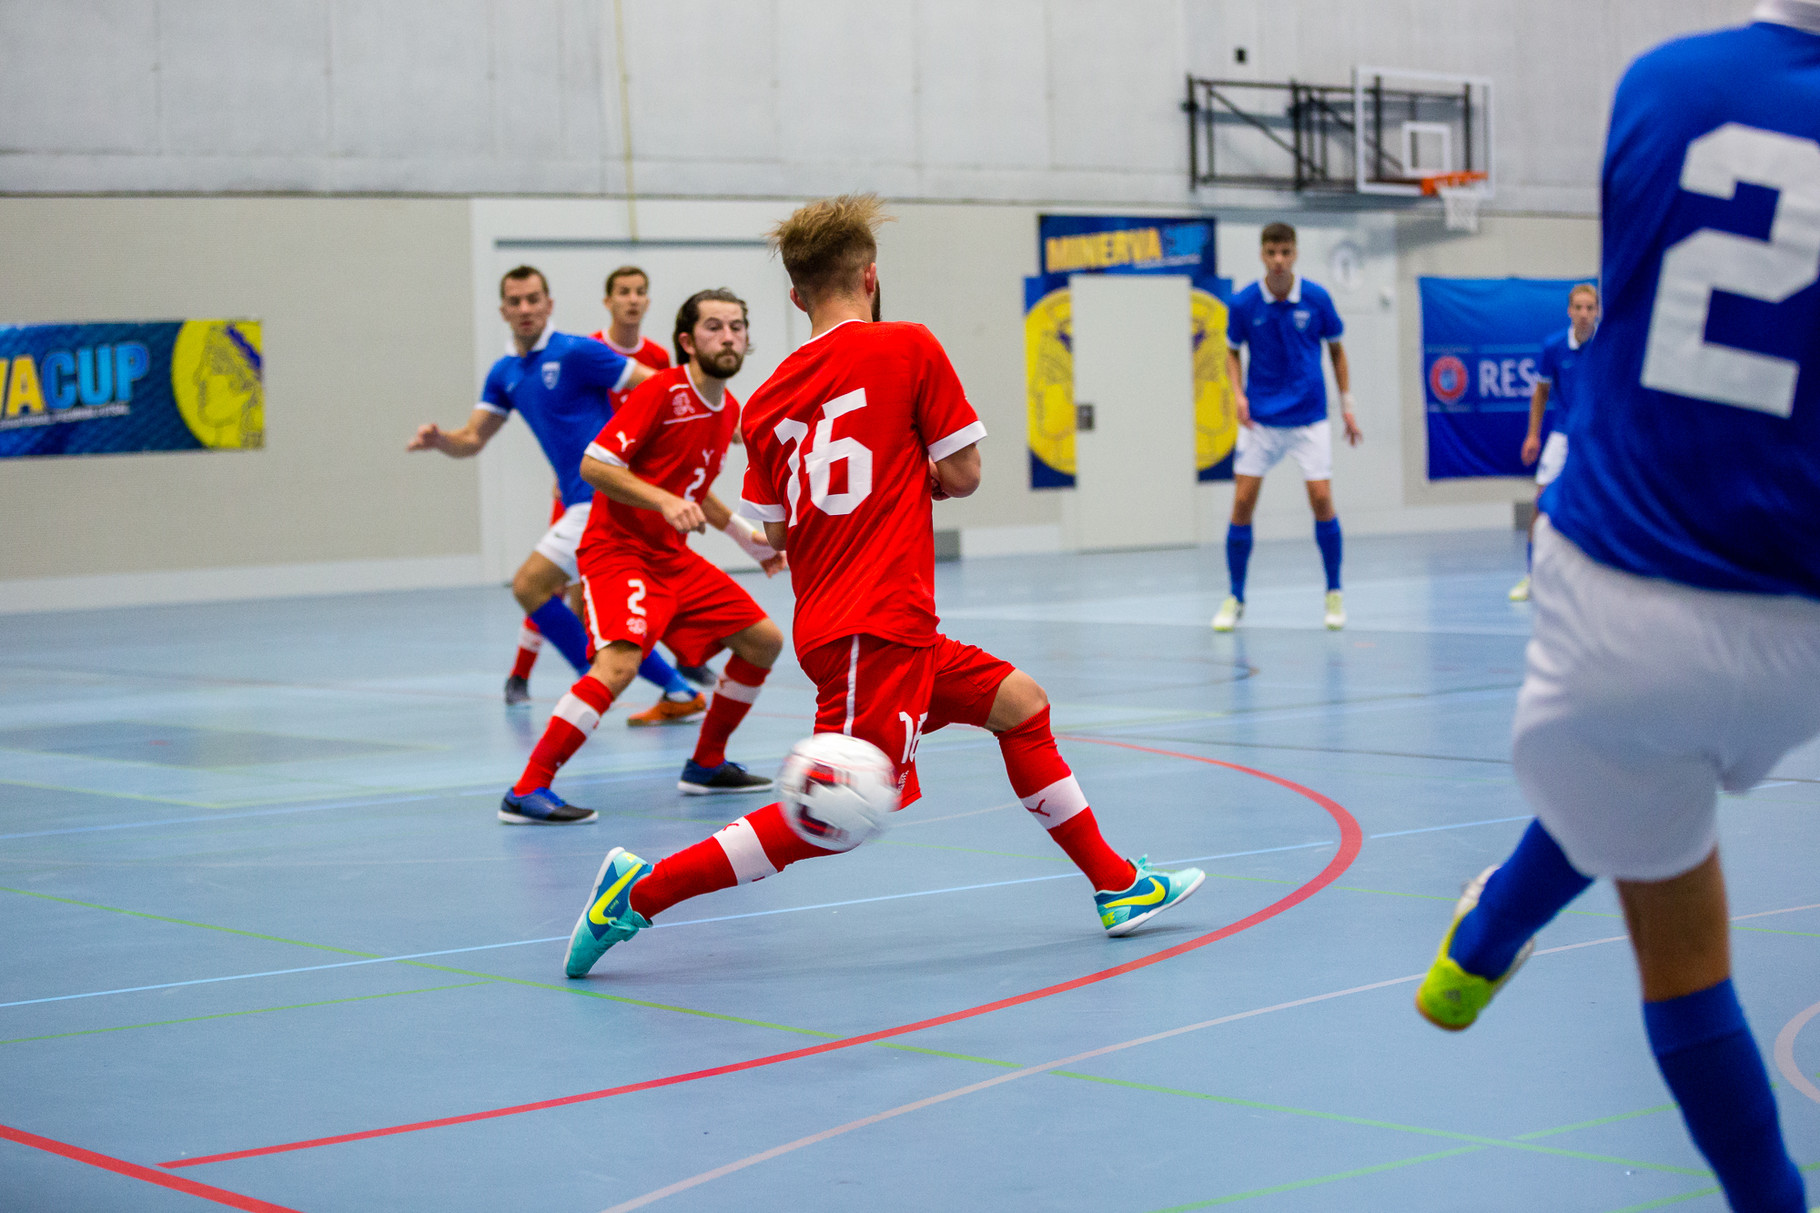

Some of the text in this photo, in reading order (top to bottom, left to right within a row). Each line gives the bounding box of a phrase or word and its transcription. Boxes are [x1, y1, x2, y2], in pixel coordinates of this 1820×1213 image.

[1640, 121, 1820, 419] 2
[41, 341, 149, 409] CUP
[774, 387, 873, 528] 16
[627, 579, 647, 617] 2
